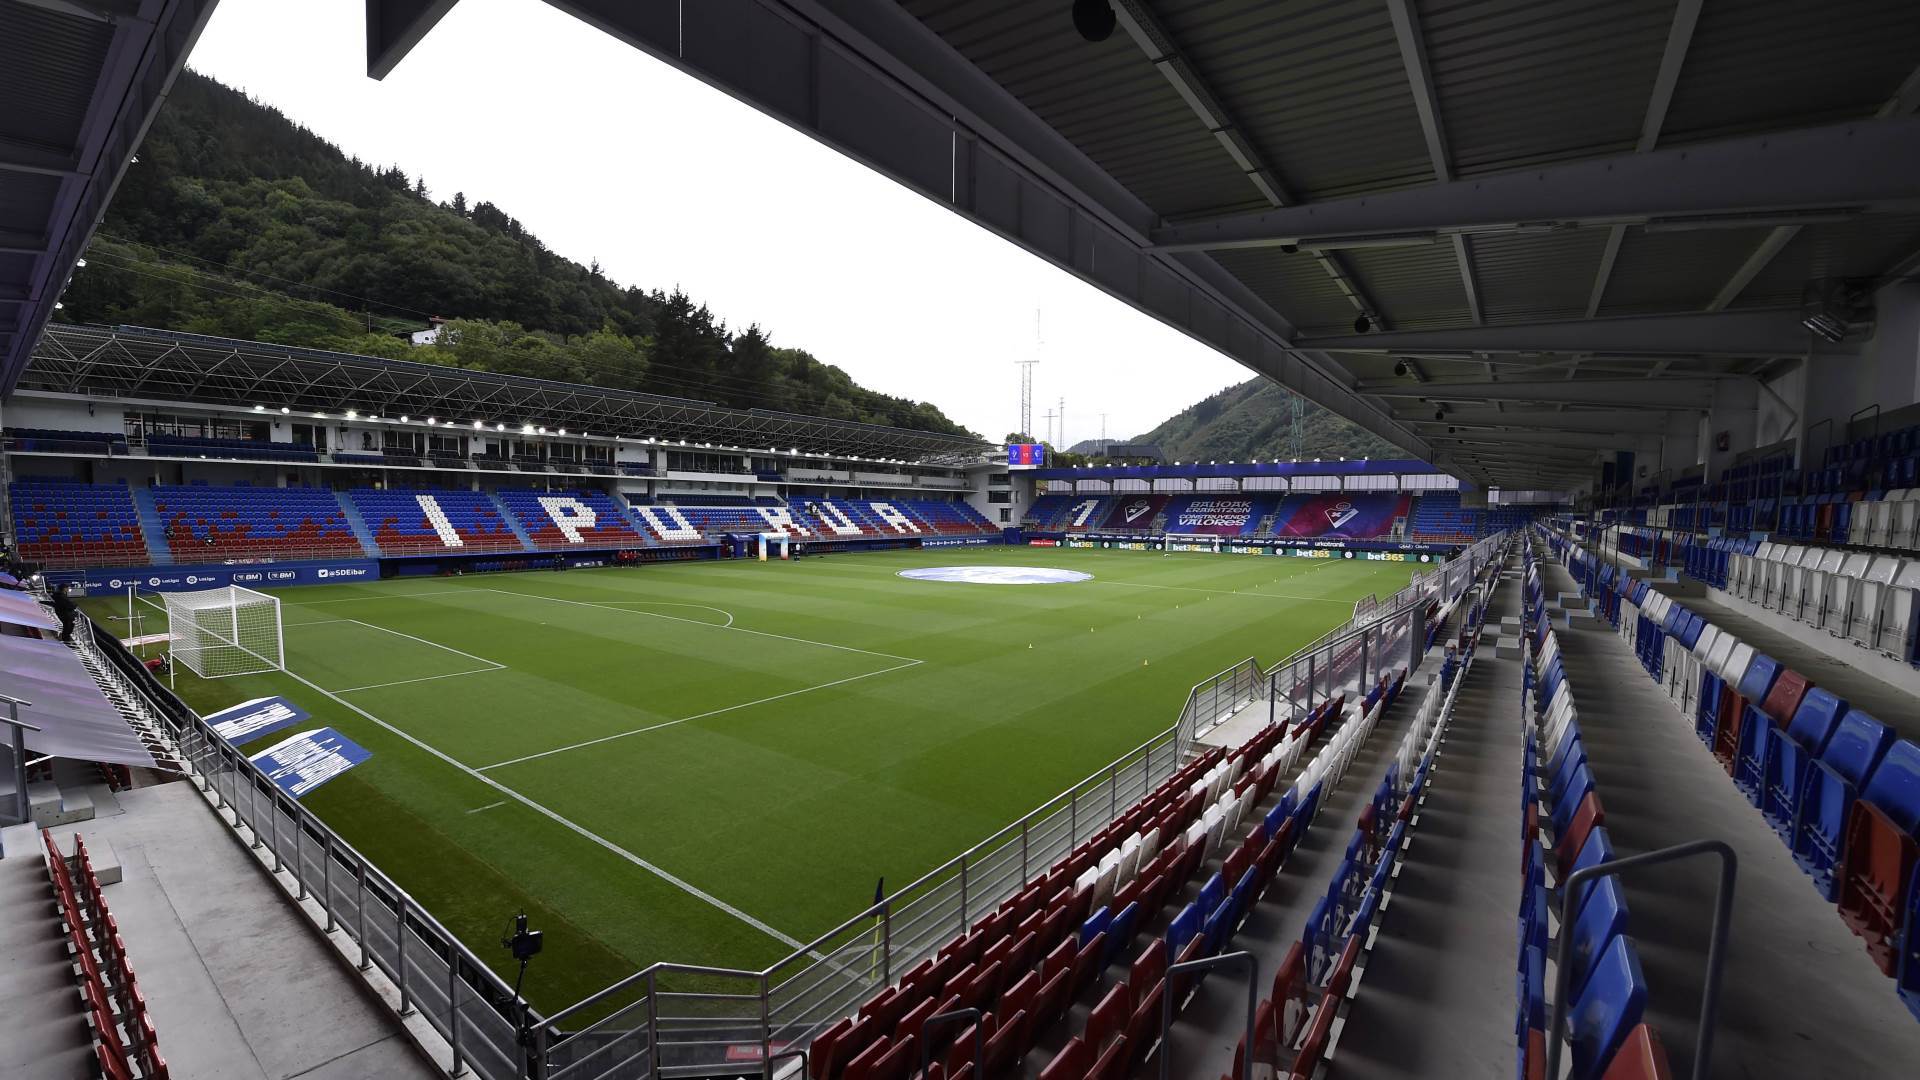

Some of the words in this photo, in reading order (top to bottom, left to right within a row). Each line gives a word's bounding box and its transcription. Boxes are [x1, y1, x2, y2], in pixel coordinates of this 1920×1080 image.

[1069, 540, 1094, 548] bet365
[1119, 541, 1145, 550] bet365
[1231, 546, 1263, 555] bet365
[1296, 548, 1330, 558] bet365
[1367, 551, 1405, 562] bet365
[328, 568, 367, 577] @SDEibar
